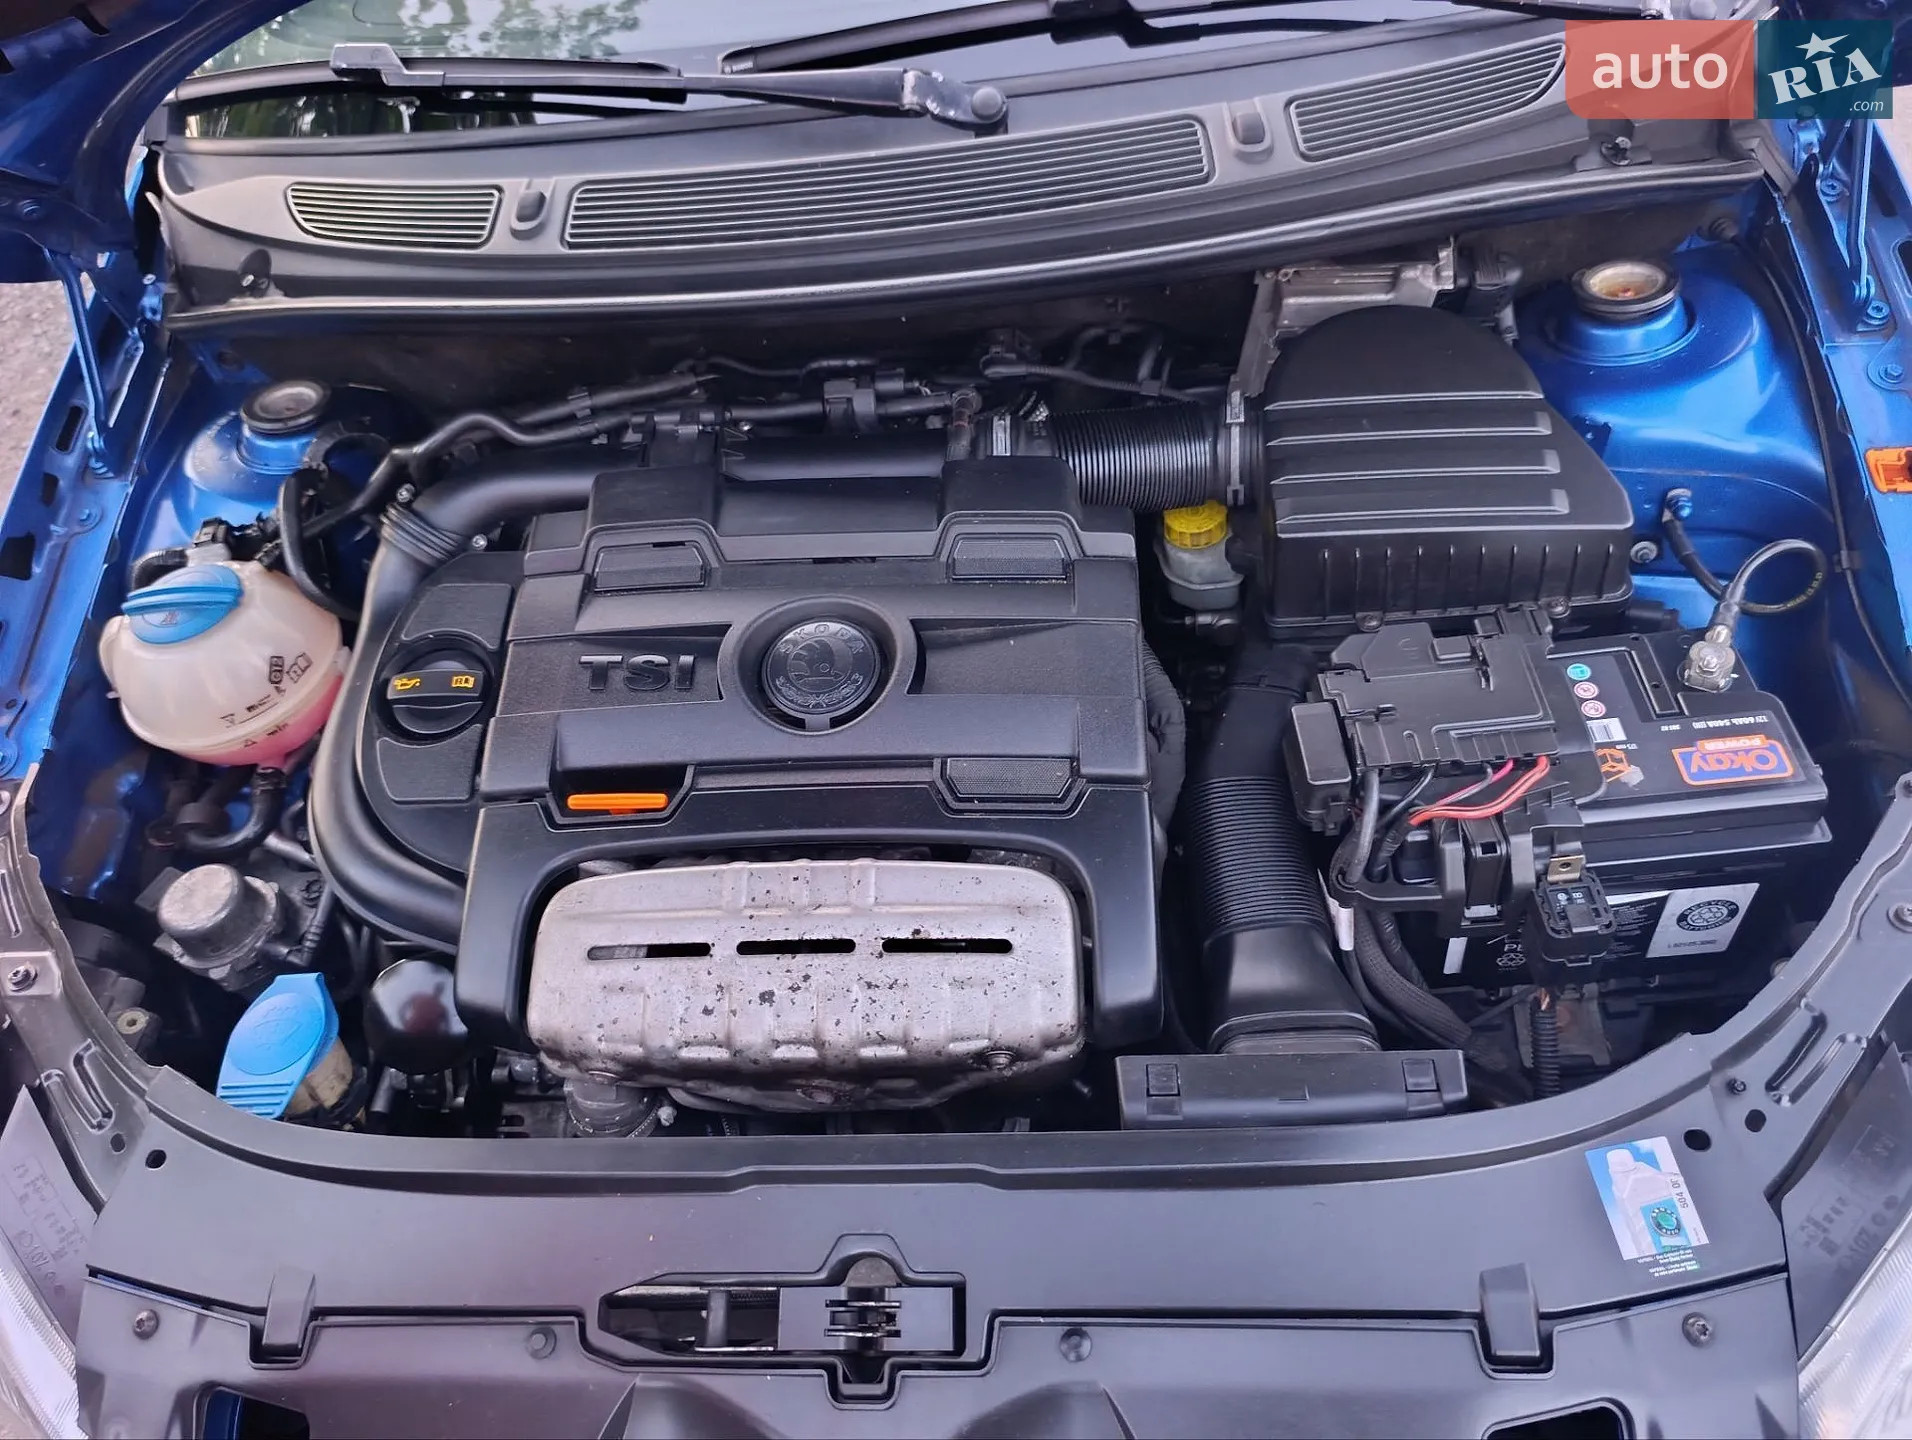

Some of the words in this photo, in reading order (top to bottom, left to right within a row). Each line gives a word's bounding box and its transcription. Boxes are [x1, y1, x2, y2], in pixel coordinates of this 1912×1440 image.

[578, 653, 696, 691] TSI
[1703, 737, 1762, 751] POWER
[1691, 751, 1777, 773] Okay
